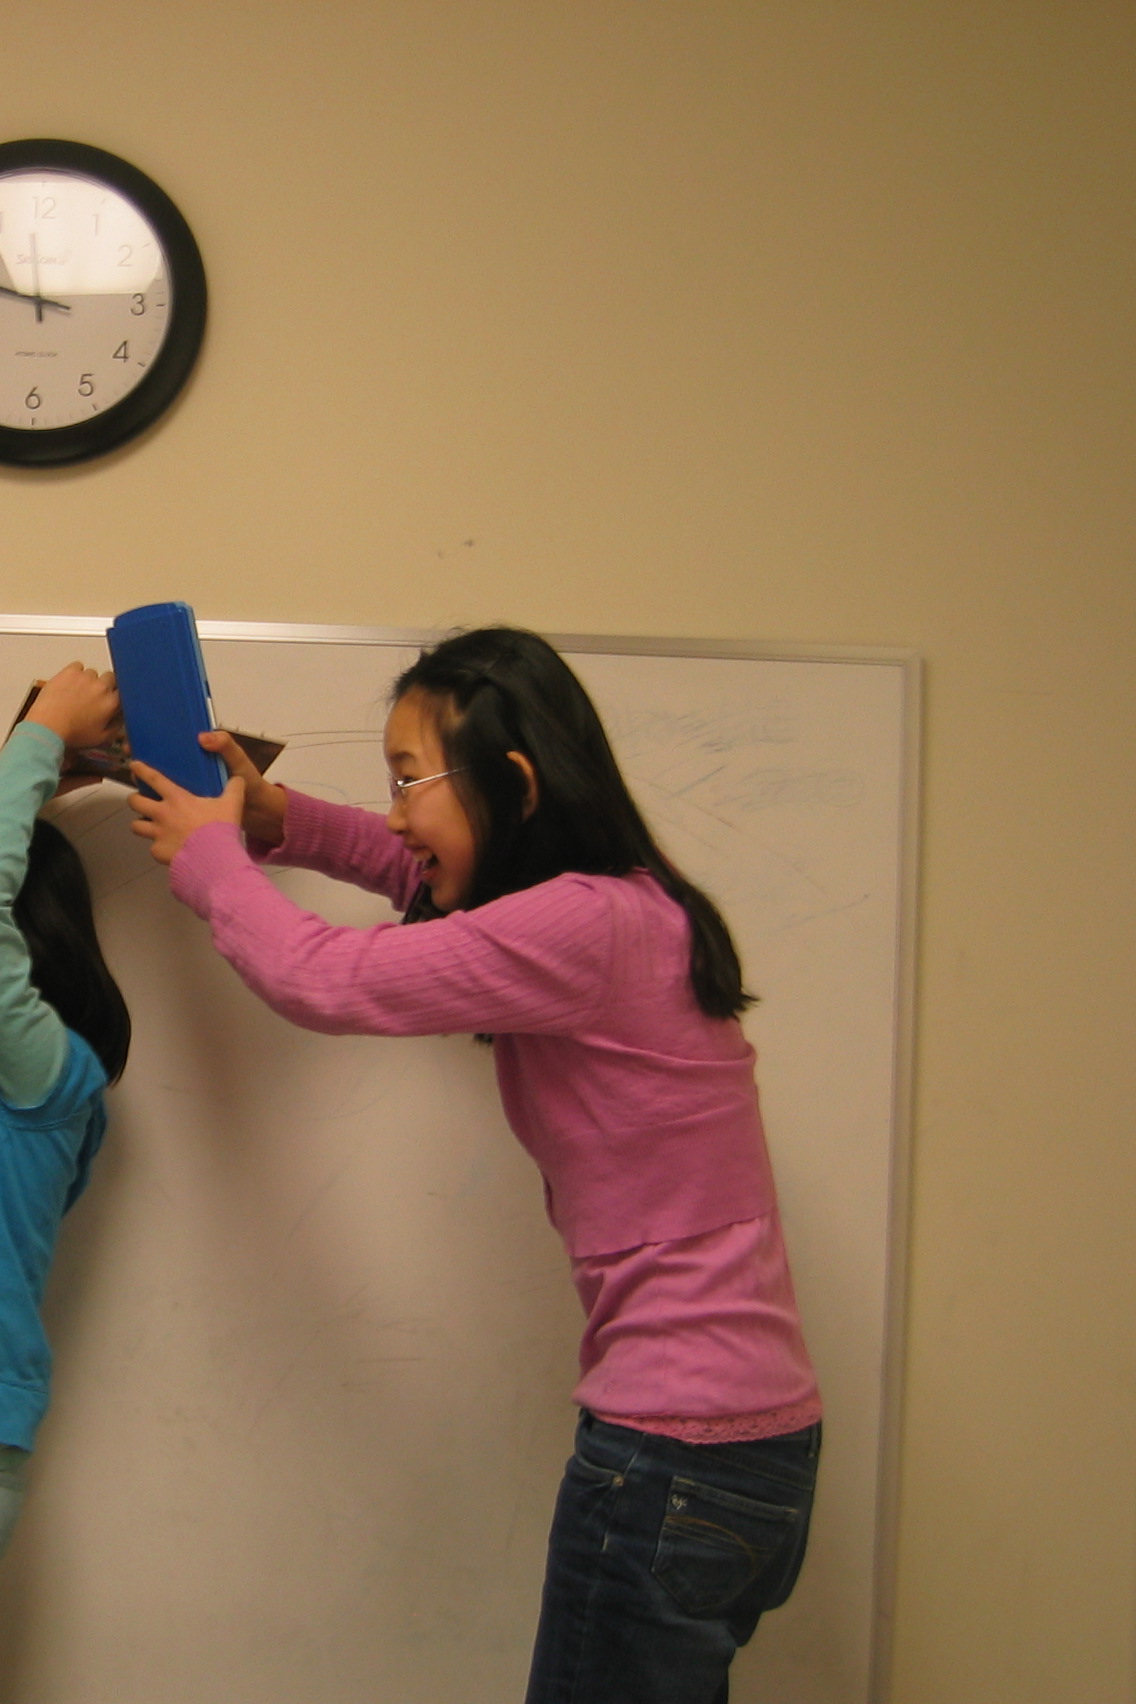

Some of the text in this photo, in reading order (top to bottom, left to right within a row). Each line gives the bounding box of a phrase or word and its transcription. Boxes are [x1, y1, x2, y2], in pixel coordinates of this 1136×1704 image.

[32, 196, 56, 219] 12
[92, 213, 100, 236] 1
[117, 244, 133, 267] 2
[130, 293, 146, 316] 3
[112, 340, 130, 363] 4
[78, 373, 95, 397] 5
[25, 386, 41, 410] 6
